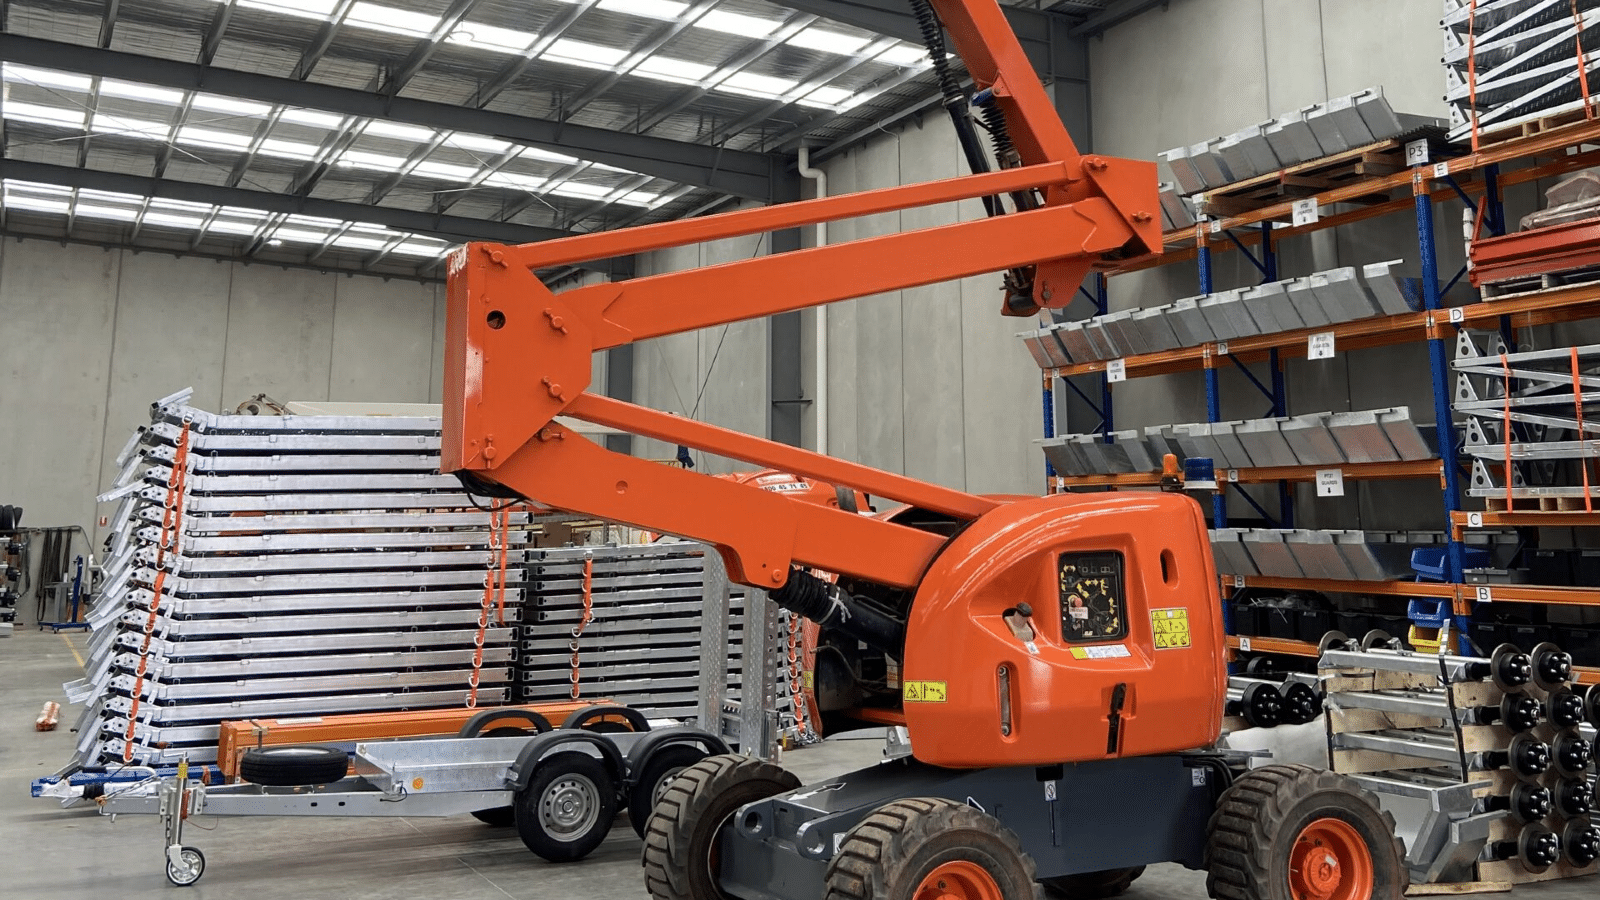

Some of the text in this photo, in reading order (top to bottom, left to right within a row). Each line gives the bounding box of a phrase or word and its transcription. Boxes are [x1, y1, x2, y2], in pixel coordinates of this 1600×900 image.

[1409, 145, 1424, 159] P3
[1437, 164, 1444, 175] E
[1452, 309, 1462, 321] D
[1220, 343, 1227, 353] D
[1229, 470, 1236, 481] C
[1470, 513, 1479, 525] C
[1236, 575, 1243, 586] B
[1479, 587, 1488, 600] B
[1242, 639, 1249, 649] A
